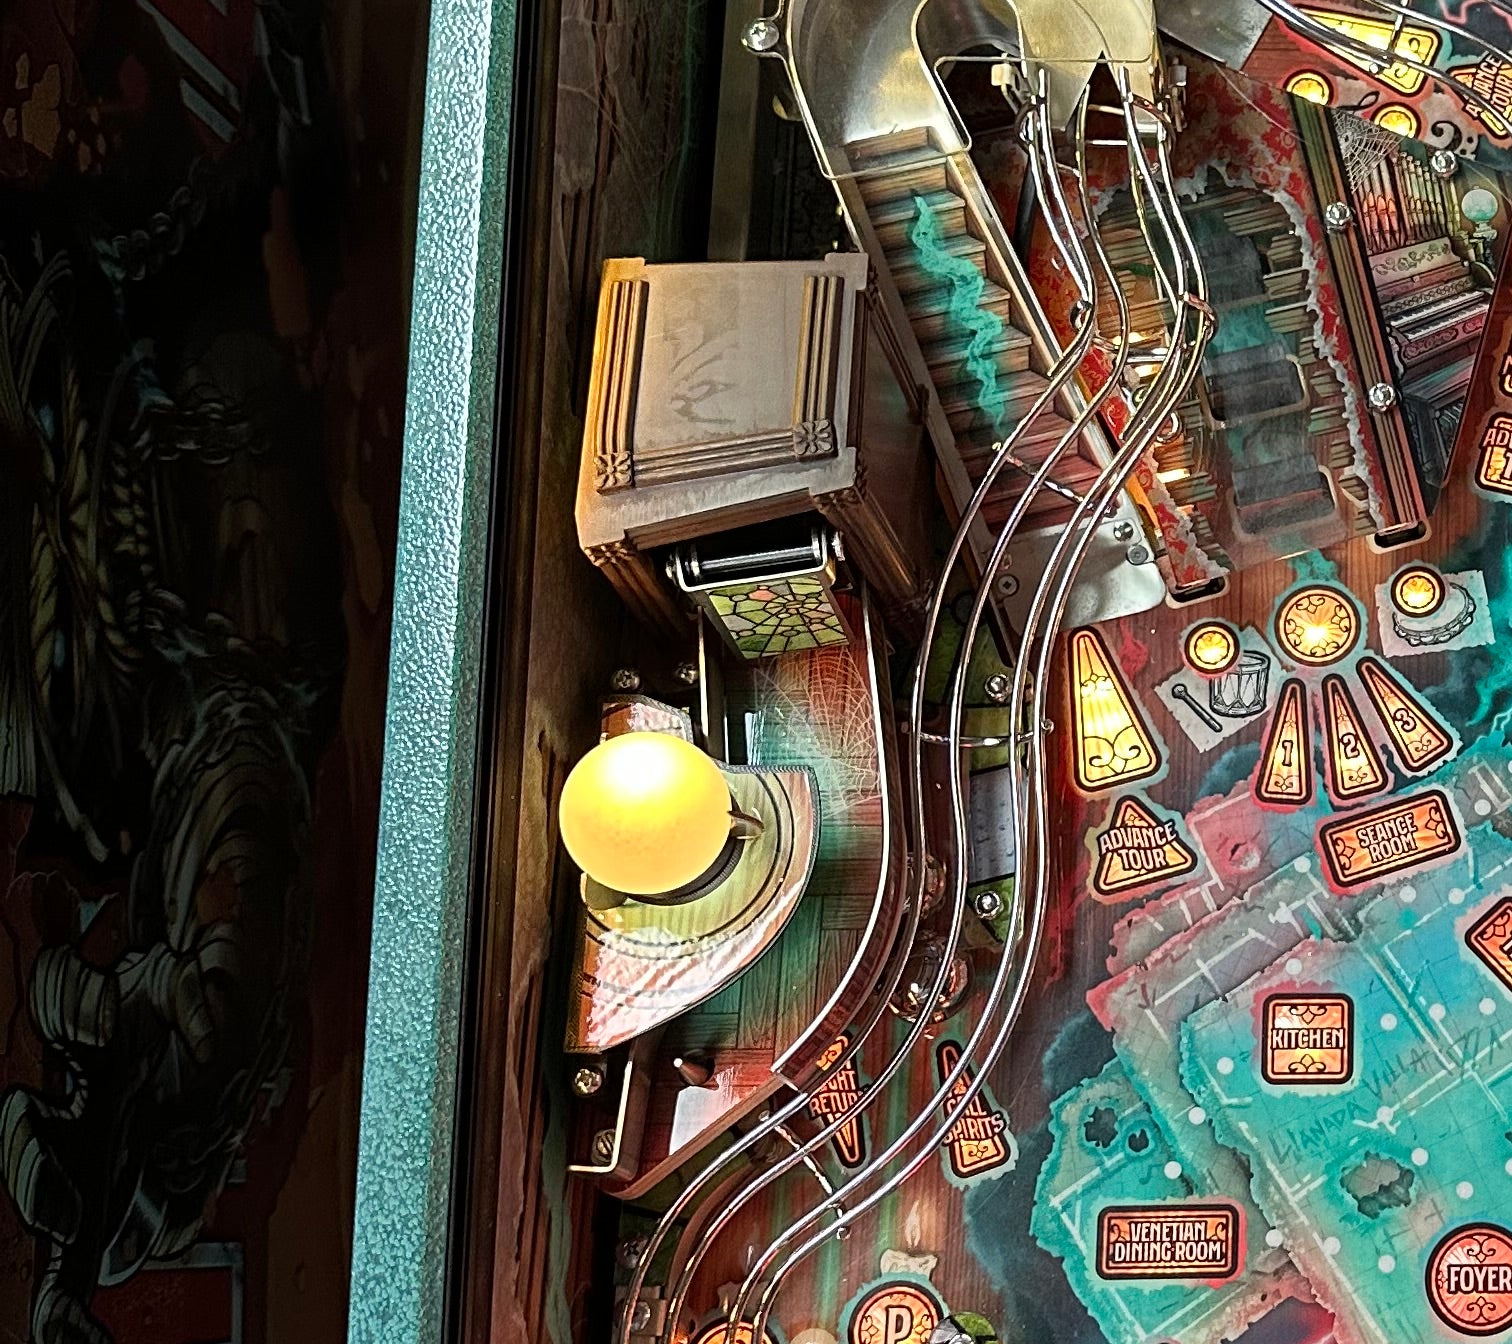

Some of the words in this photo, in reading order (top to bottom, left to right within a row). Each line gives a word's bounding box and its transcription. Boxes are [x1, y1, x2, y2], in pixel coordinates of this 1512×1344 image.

[1394, 709, 1417, 733] 3
[1282, 740, 1294, 766] 1
[1341, 733, 1360, 758] 2
[1102, 822, 1176, 852] ADVANCE
[1359, 813, 1418, 847] SEANCE
[1118, 848, 1167, 869] TOUR
[1369, 833, 1418, 863] ROOM
[1271, 1028, 1344, 1048] KITCHEN
[1130, 1221, 1206, 1242] VENETIAN
[1114, 1241, 1172, 1262] DINING
[1174, 1241, 1221, 1262] ROOM
[1447, 1266, 1512, 1293] FOYER
